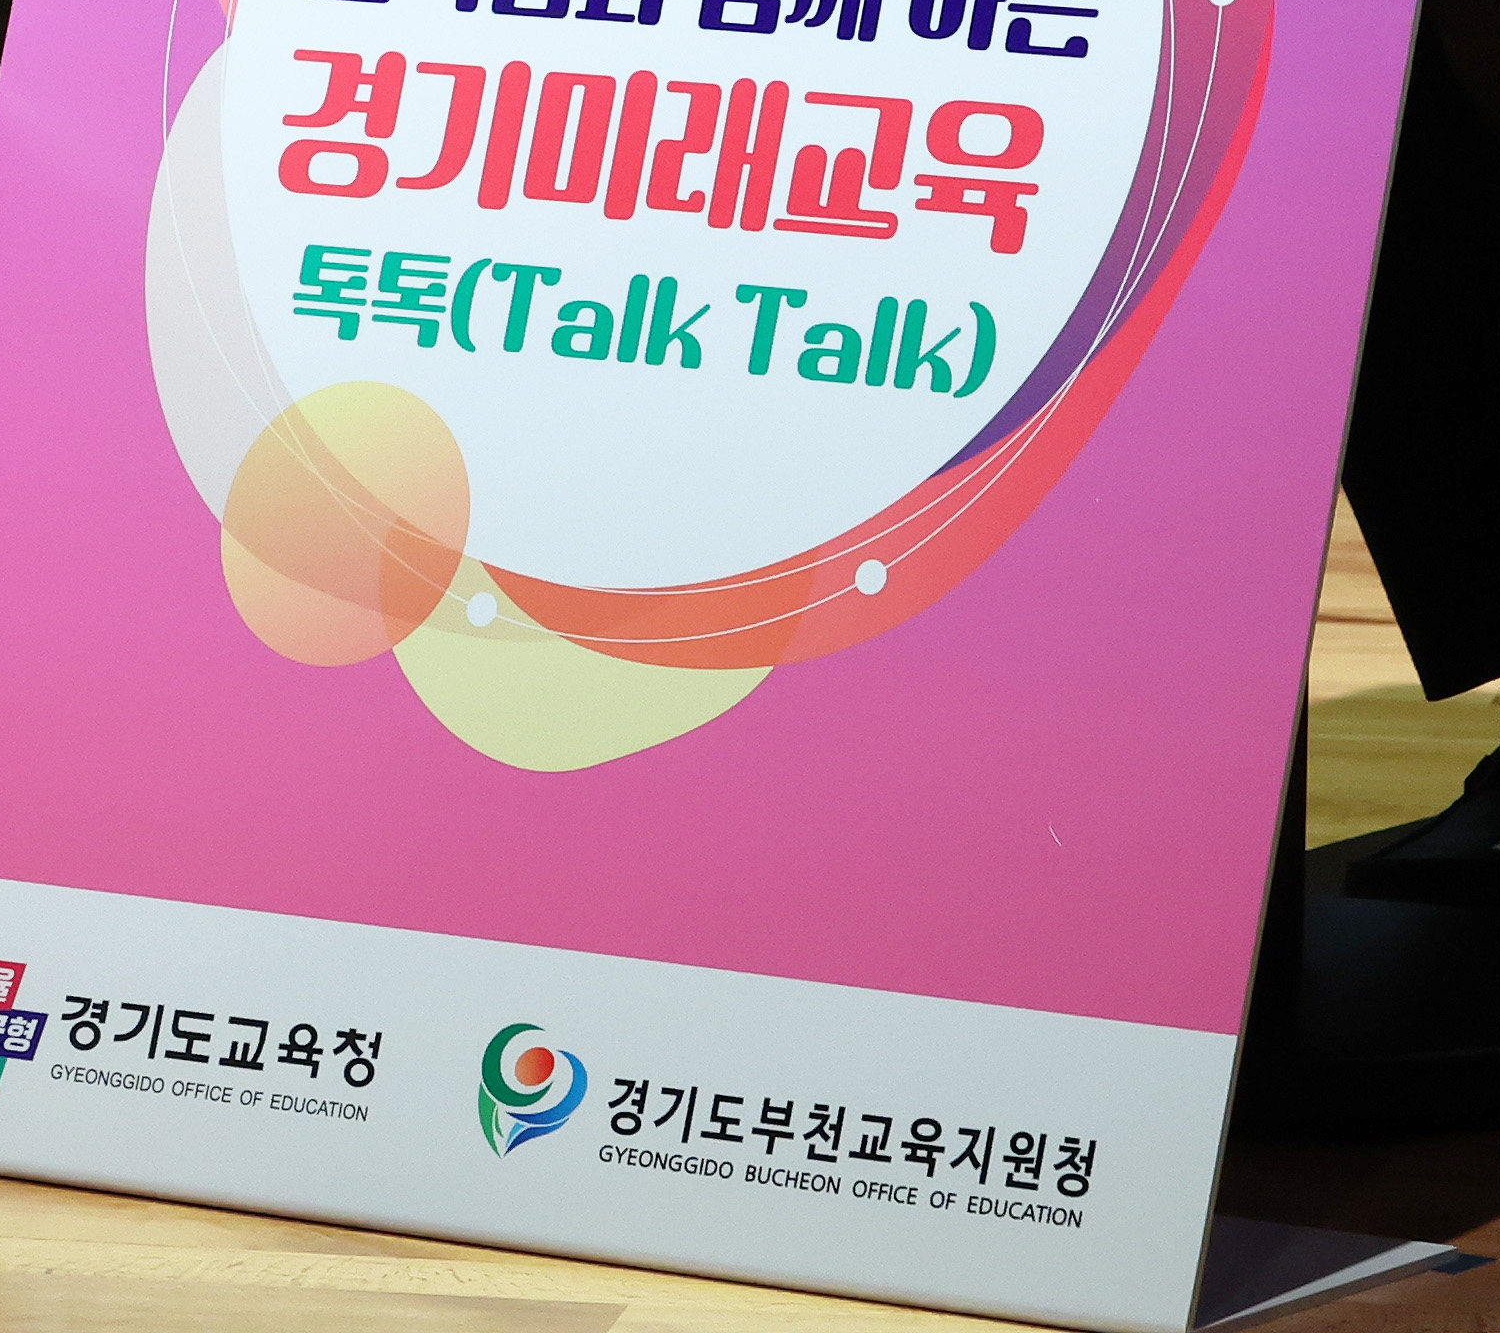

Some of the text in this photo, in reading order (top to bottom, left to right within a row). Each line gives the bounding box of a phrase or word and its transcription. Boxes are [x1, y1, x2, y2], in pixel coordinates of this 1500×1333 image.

[279, 50, 1044, 254] 경기미래교육
[293, 245, 996, 398] 톡톡(Talk Talk)
[50, 1064, 369, 1122] GYEONGGIDO OFFICE OF EDUCATION
[61, 995, 382, 1088] 경기도교육청
[599, 1144, 1084, 1229] GYEONGGIDO BUCHEON OFFICE OF EDUCATION
[605, 1077, 1098, 1199] 경기도부천교육지원청
